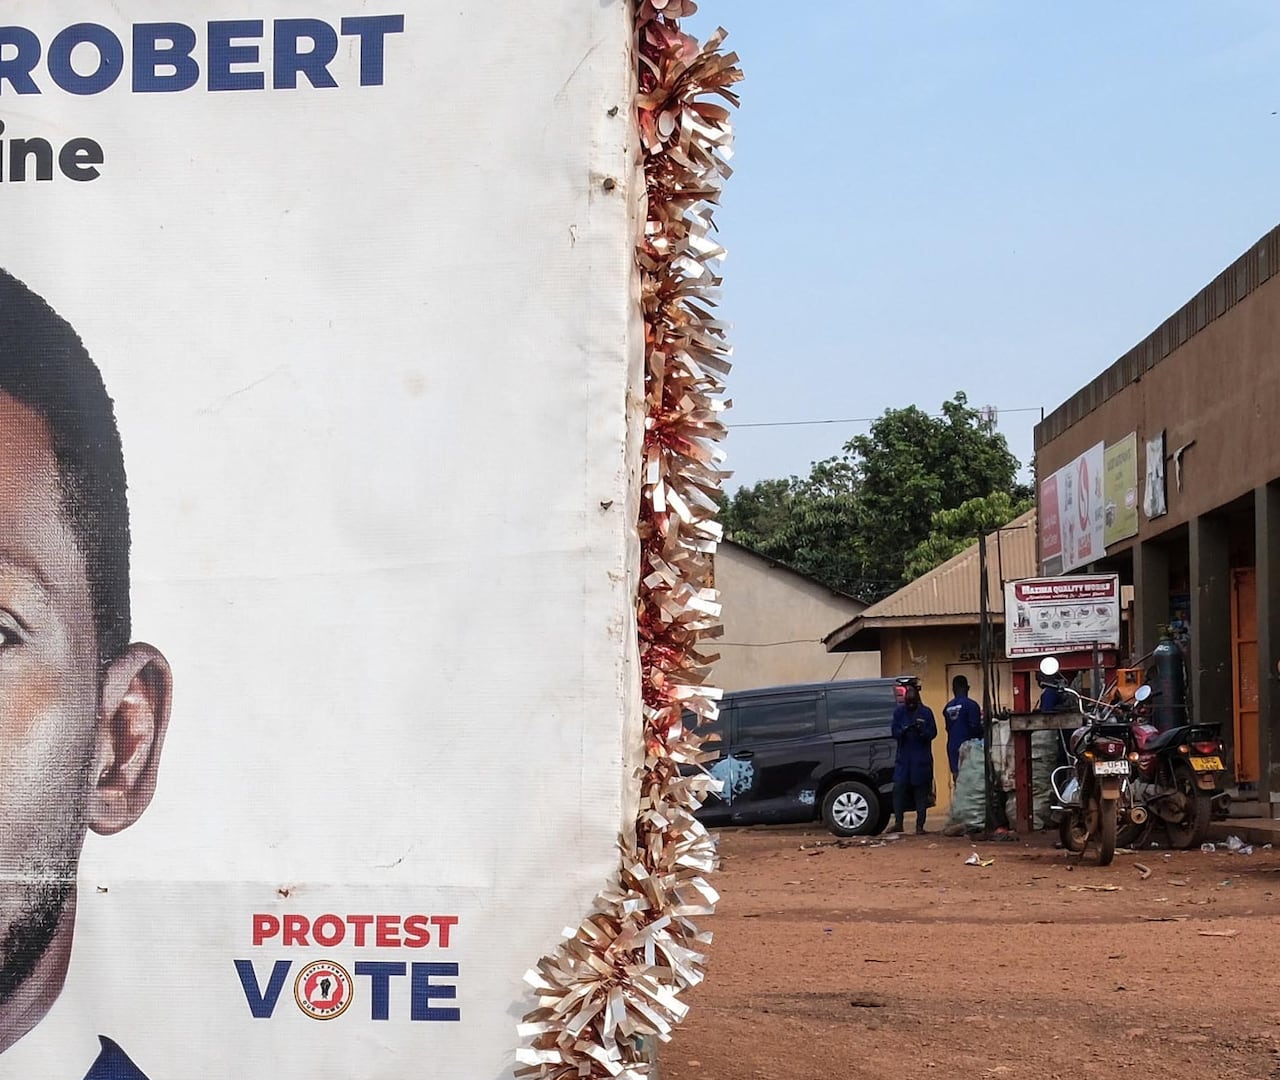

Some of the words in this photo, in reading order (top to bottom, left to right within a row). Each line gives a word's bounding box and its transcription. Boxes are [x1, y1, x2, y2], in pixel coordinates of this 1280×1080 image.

[1053, 583, 1083, 594] QUALITY
[252, 914, 459, 948] PROTEST
[233, 959, 461, 1022] VOTE
